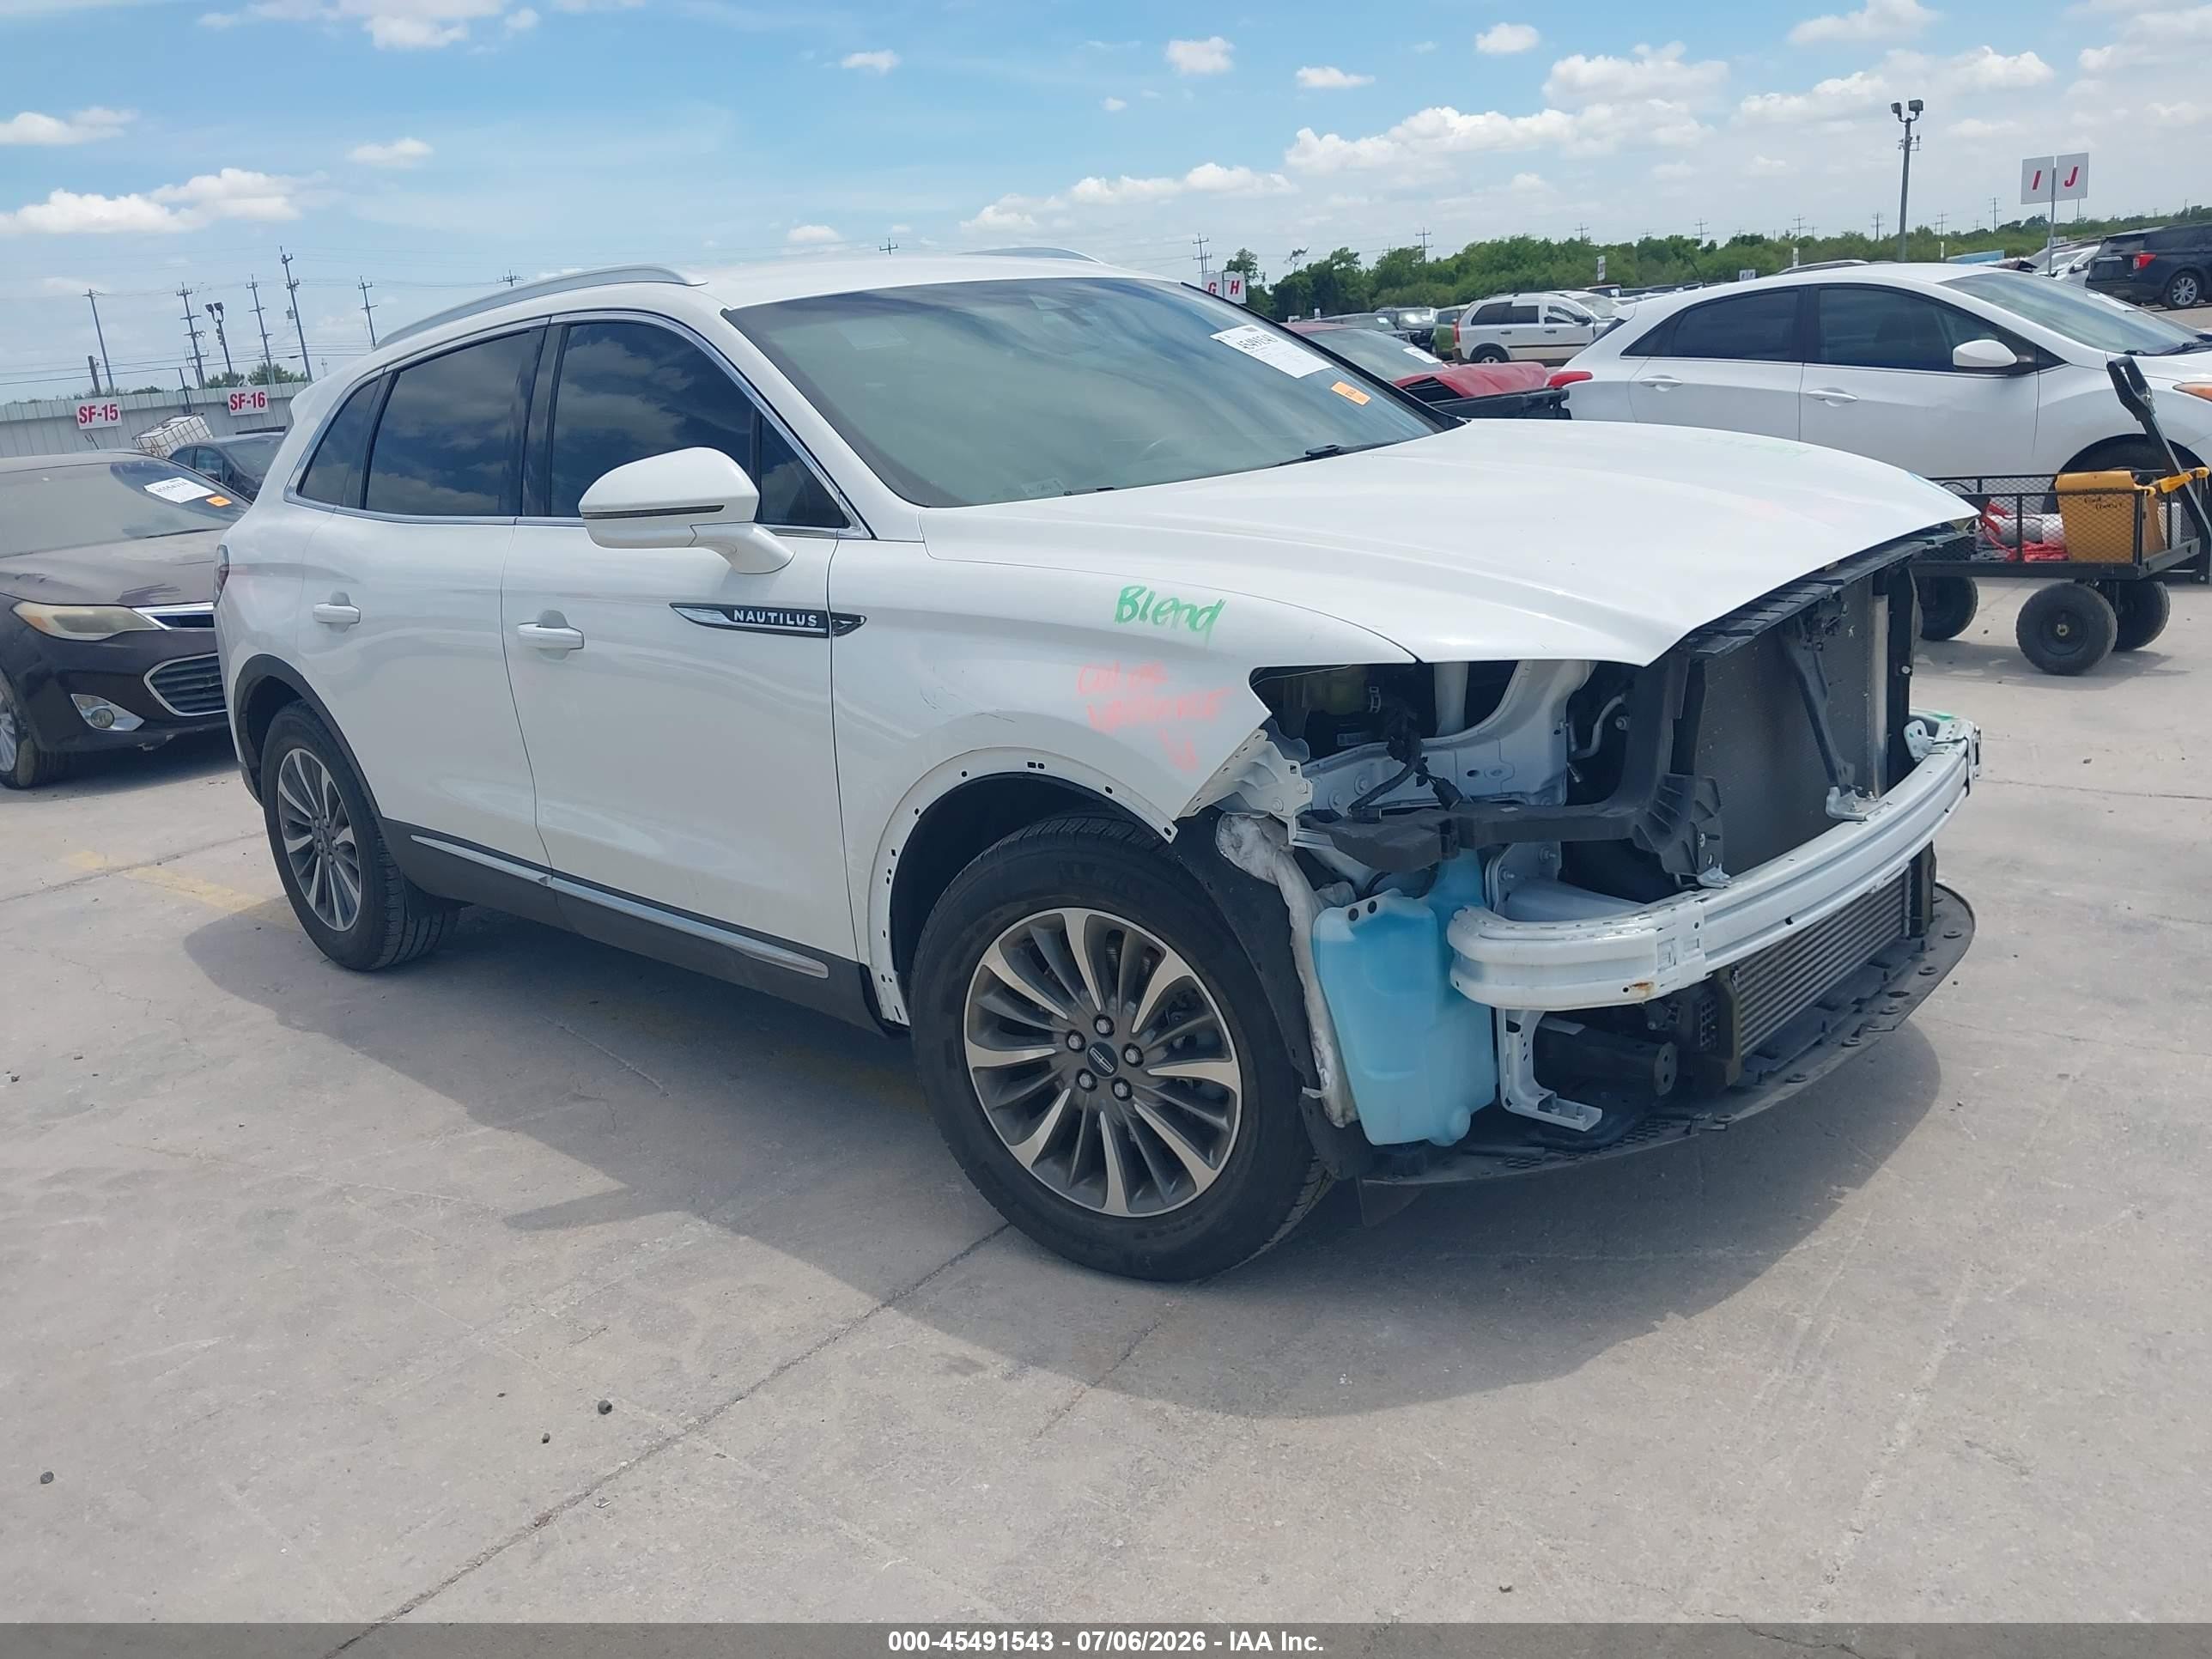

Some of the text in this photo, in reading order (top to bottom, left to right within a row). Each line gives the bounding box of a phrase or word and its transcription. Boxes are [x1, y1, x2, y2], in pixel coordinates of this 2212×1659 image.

[2032, 170, 2042, 190] I
[2063, 166, 2079, 187] J
[1208, 282, 1218, 295] G
[1230, 280, 1241, 295] H
[229, 392, 266, 411] SF-16
[78, 404, 118, 424] SF-15
[733, 609, 818, 627] NAUTILUS
[1114, 585, 1226, 646] Blend
